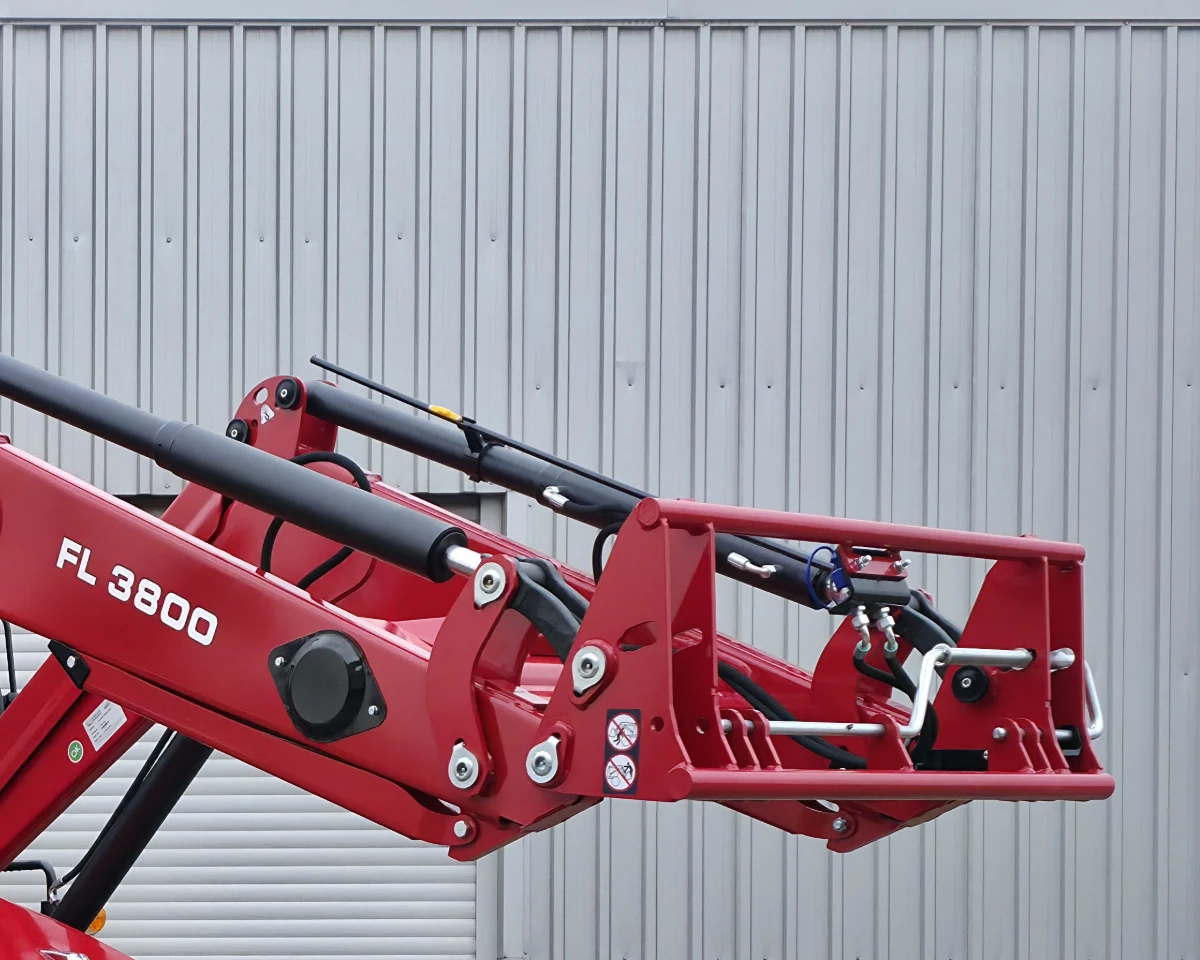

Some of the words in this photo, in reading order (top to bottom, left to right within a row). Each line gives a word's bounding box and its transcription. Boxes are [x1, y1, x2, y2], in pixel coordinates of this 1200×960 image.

[56, 536, 97, 586] FL
[107, 564, 218, 646] 3800
[70, 744, 81, 758] OK
